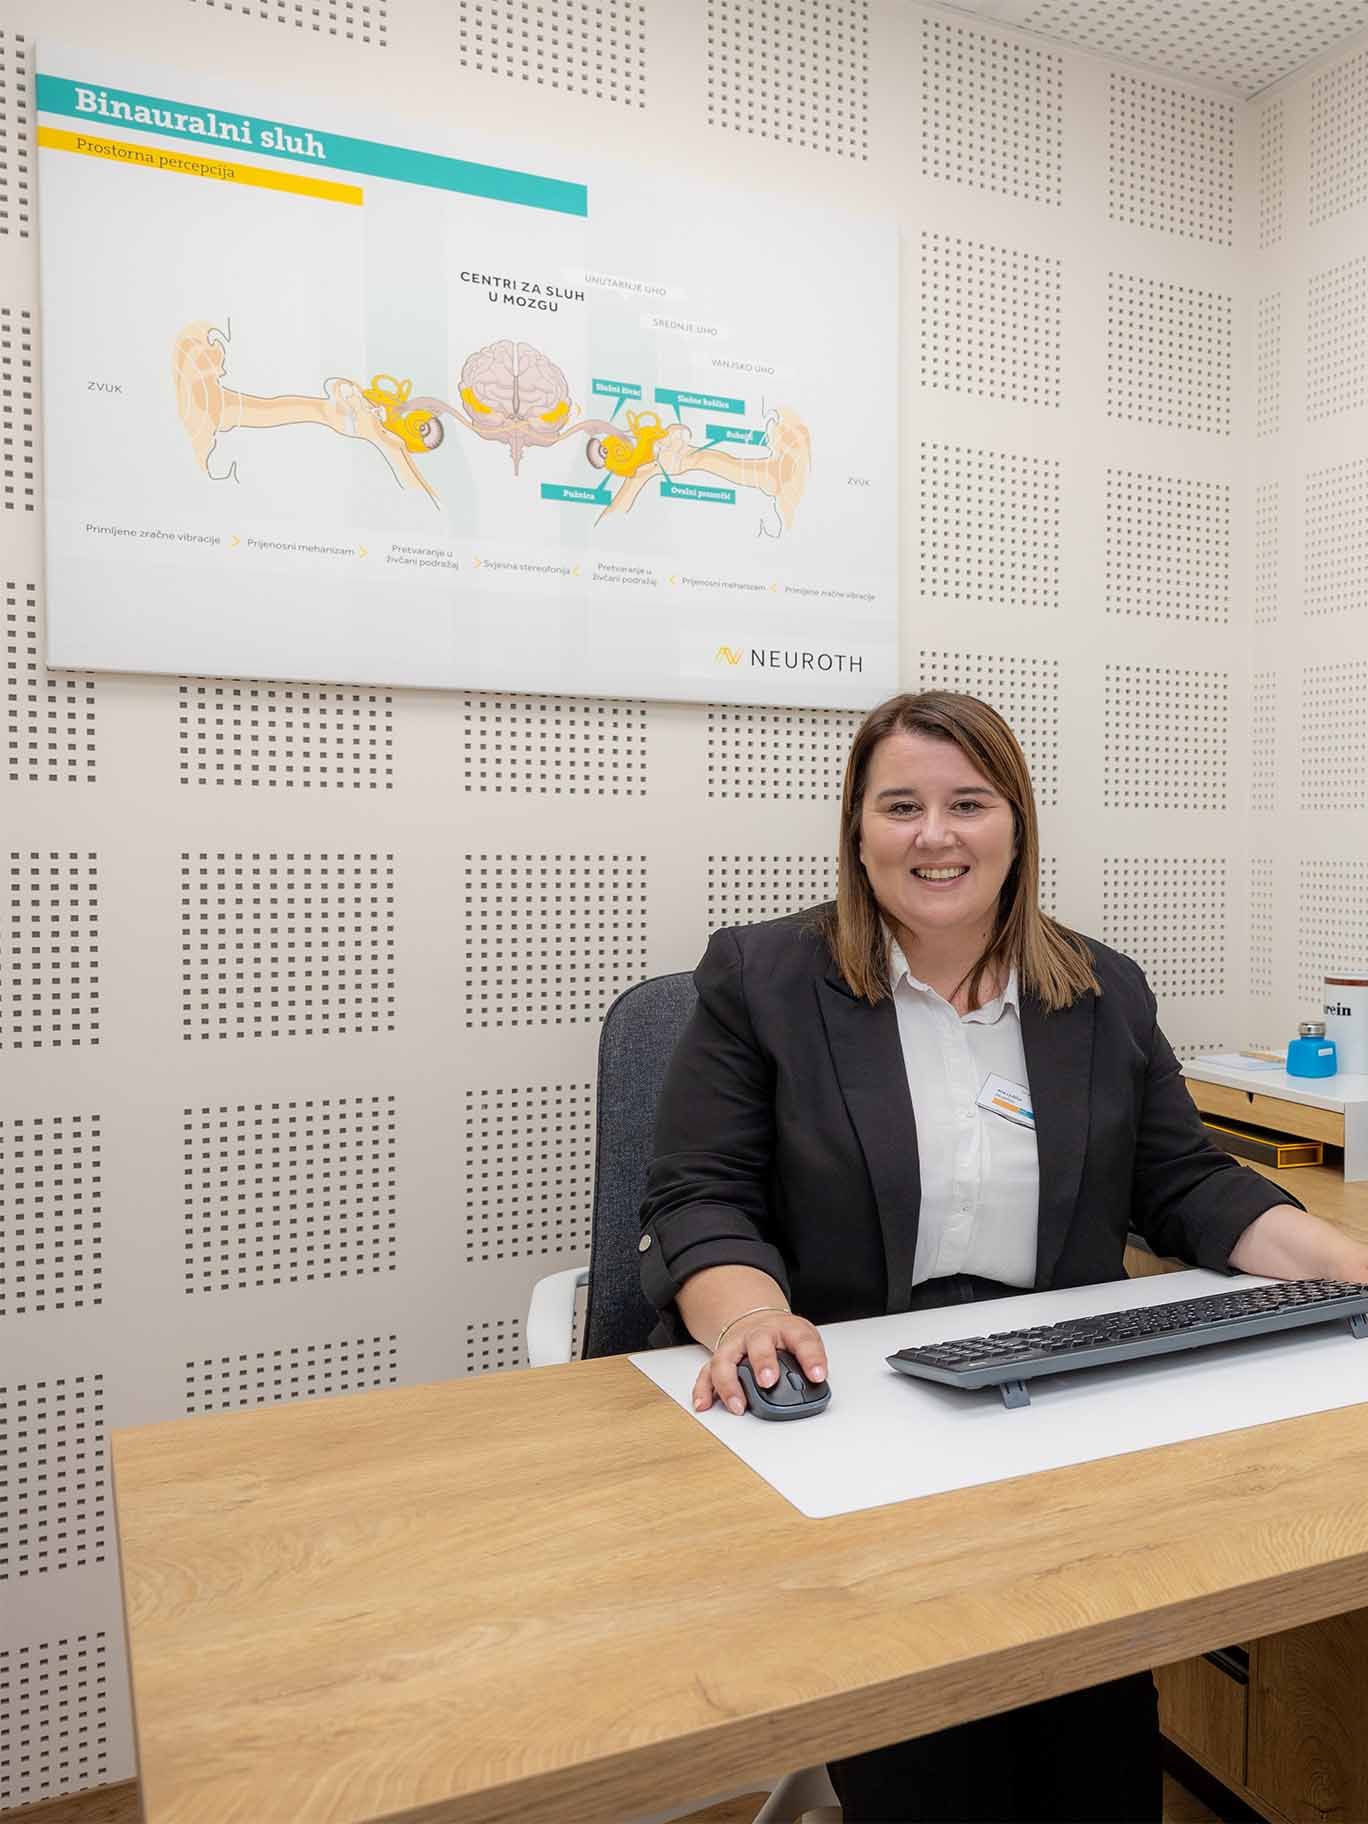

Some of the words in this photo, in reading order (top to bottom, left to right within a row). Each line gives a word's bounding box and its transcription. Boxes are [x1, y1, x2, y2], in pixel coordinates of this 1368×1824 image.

[74, 87, 252, 145] Binauralni
[260, 127, 327, 159] sluh
[76, 137, 154, 163] Prostorna
[159, 153, 236, 180] percepcija
[460, 271, 517, 290] CENTRI
[521, 281, 542, 295] ZA
[546, 286, 585, 301] SLUH
[645, 286, 667, 296] UHO
[488, 291, 498, 303] U
[503, 294, 559, 312] MOZGU
[696, 326, 718, 336] UHO
[754, 365, 775, 375] UHO
[87, 381, 123, 394] ZVUK
[86, 523, 137, 537] Primljene
[139, 529, 175, 541] zračne
[177, 532, 221, 545] vibracije
[247, 538, 296, 550] Prijenosni
[298, 542, 354, 556] mehanizam
[391, 544, 445, 558] Pretvaranje
[446, 550, 453, 558] u
[483, 559, 518, 571] Svjesna
[751, 649, 863, 673] NEUROTH
